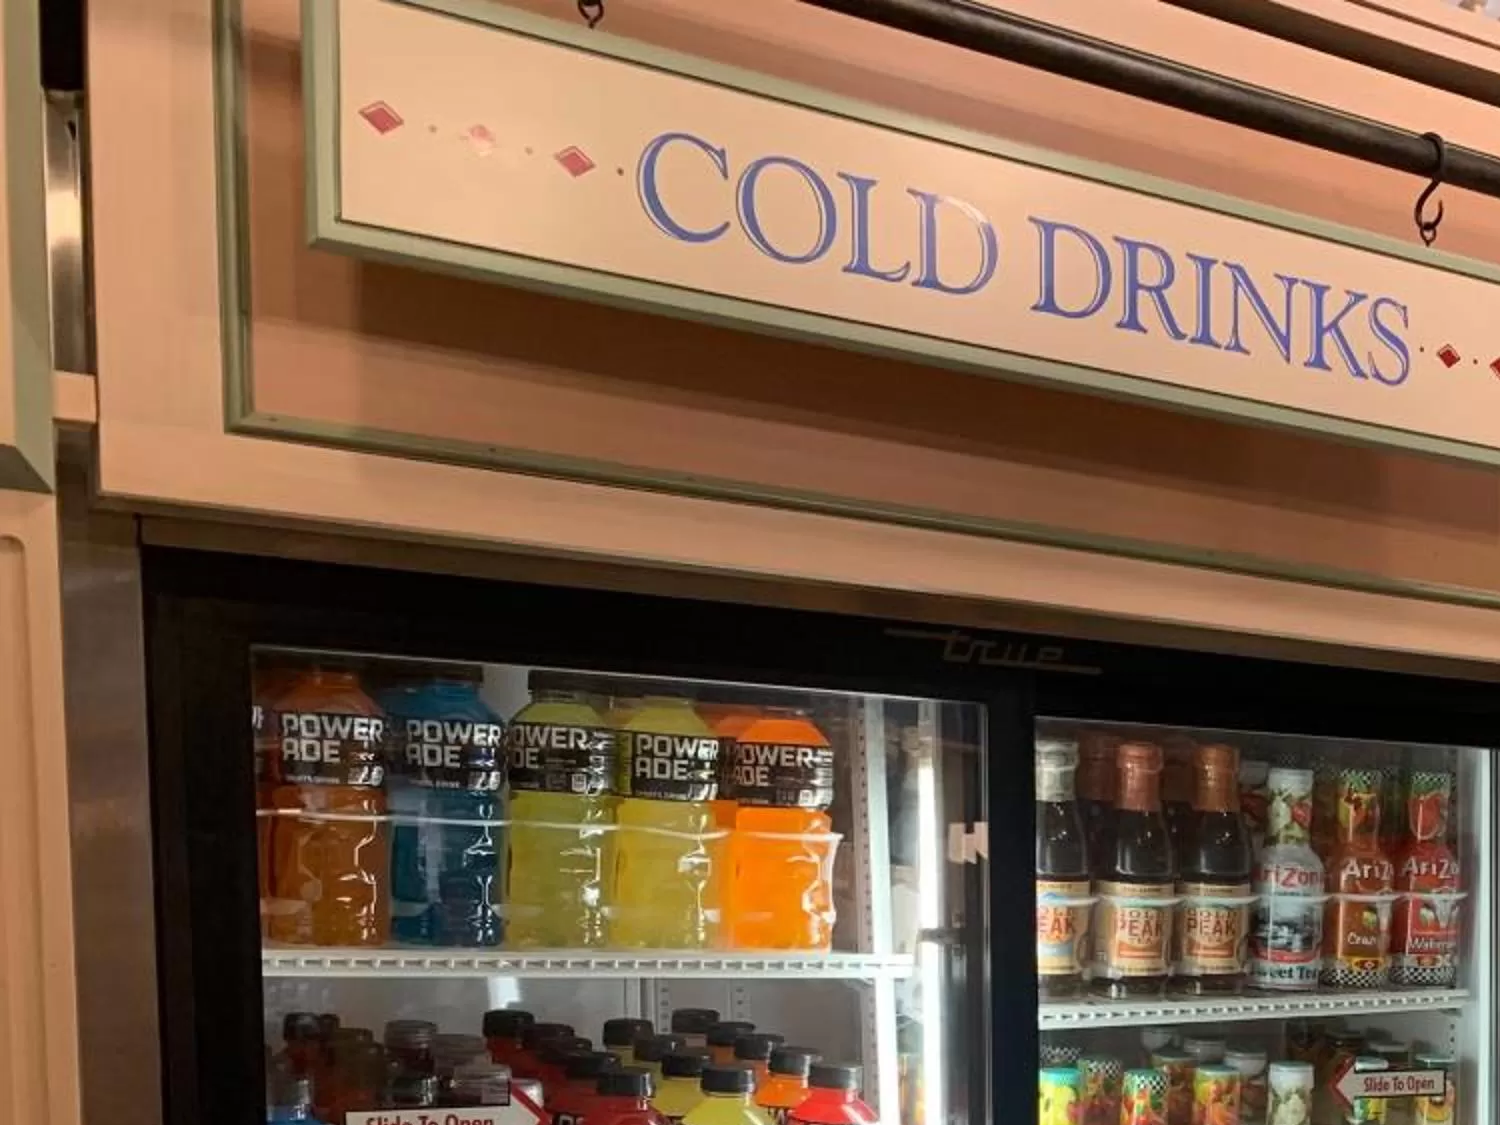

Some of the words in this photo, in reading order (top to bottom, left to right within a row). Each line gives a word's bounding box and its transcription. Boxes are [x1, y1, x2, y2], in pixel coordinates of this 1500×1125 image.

[637, 132, 999, 296] COLD
[1028, 215, 1412, 388] DRINKS
[281, 713, 385, 743] POWER
[406, 719, 502, 747] POWER
[510, 725, 588, 750] OWER
[282, 738, 341, 763] ADE
[406, 743, 461, 769] ADE
[511, 748, 539, 769] DE
[635, 735, 719, 761] POWER
[635, 758, 688, 781] ADE
[1186, 917, 1236, 937] PEAK
[1363, 1077, 1390, 1092] Slide
[1392, 1077, 1405, 1091] To
[1406, 1076, 1435, 1092] Open
